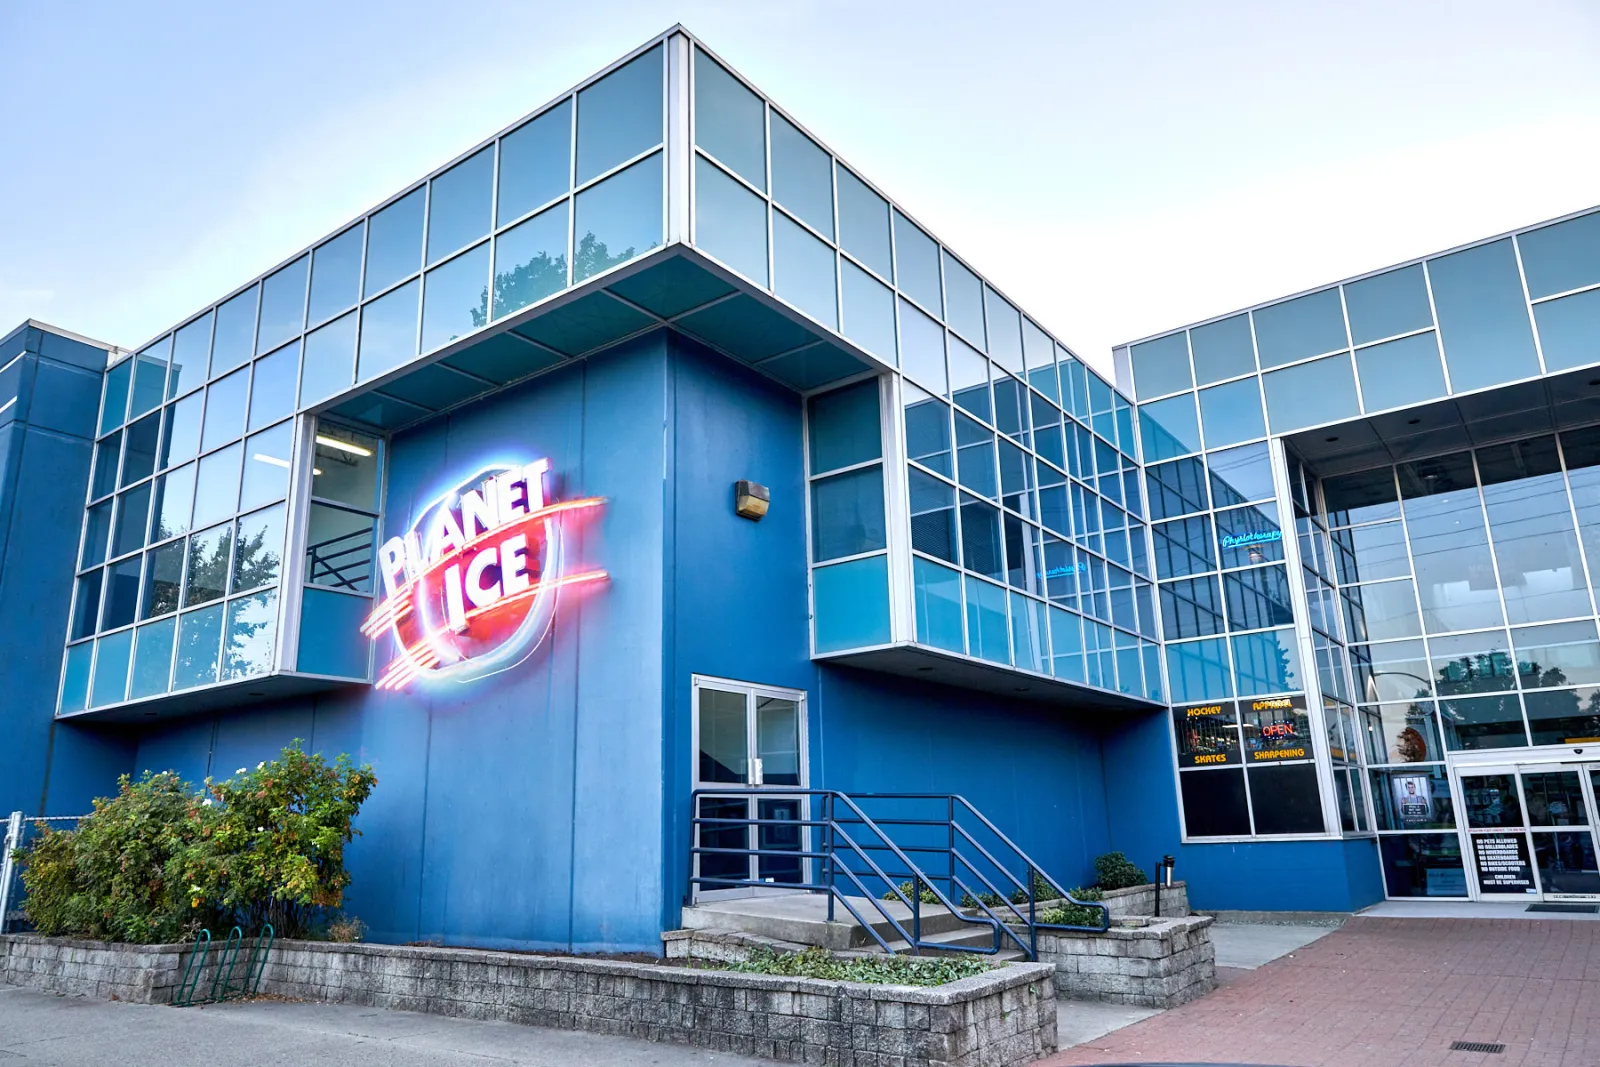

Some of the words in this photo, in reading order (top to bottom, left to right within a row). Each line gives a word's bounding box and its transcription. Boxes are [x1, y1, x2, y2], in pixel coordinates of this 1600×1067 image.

[379, 458, 551, 601] PLANET
[1223, 530, 1282, 547] Physiotherapy
[445, 534, 531, 634] ICE
[1253, 699, 1292, 710] APPAREL
[1187, 706, 1221, 716] HOCKEY
[1262, 723, 1293, 736] OPEN
[1194, 754, 1226, 763] SKATES
[1254, 748, 1304, 759] SHARPENING
